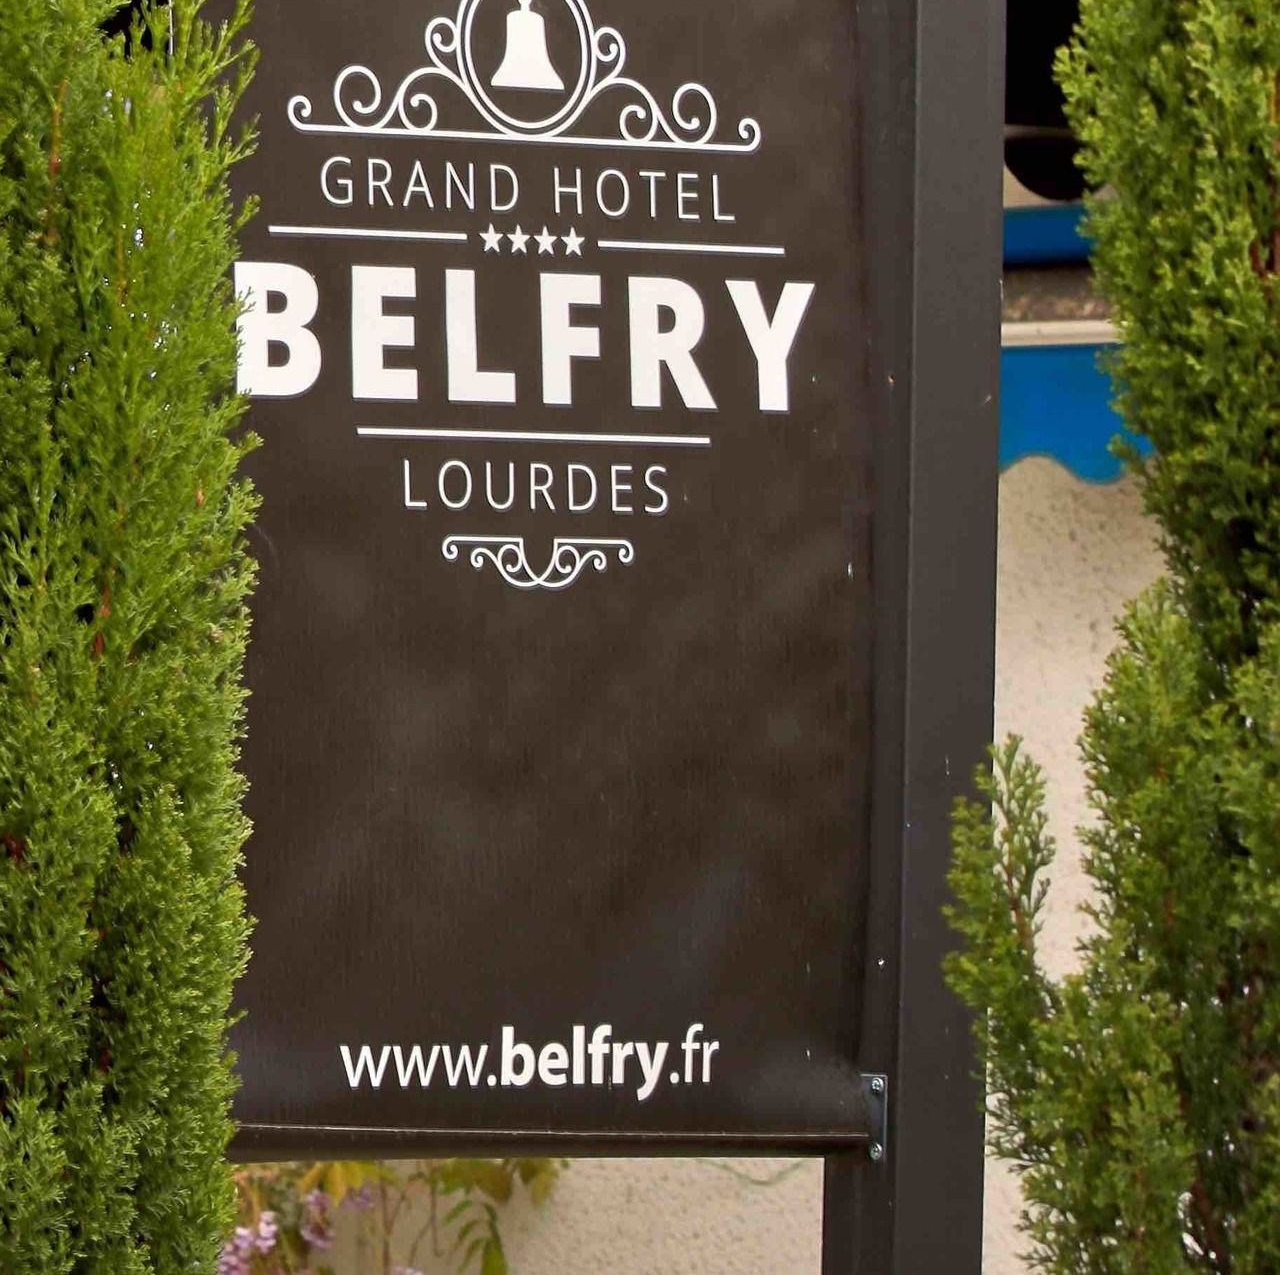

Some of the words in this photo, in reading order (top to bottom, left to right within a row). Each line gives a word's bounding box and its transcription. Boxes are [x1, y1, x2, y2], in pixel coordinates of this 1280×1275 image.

[320, 156, 519, 212] GRAND
[553, 166, 736, 221] HOTEL
[234, 260, 816, 412] BELFRY
[403, 459, 669, 514] LOURDES
[339, 1023, 720, 1101] www.belfry.fr
